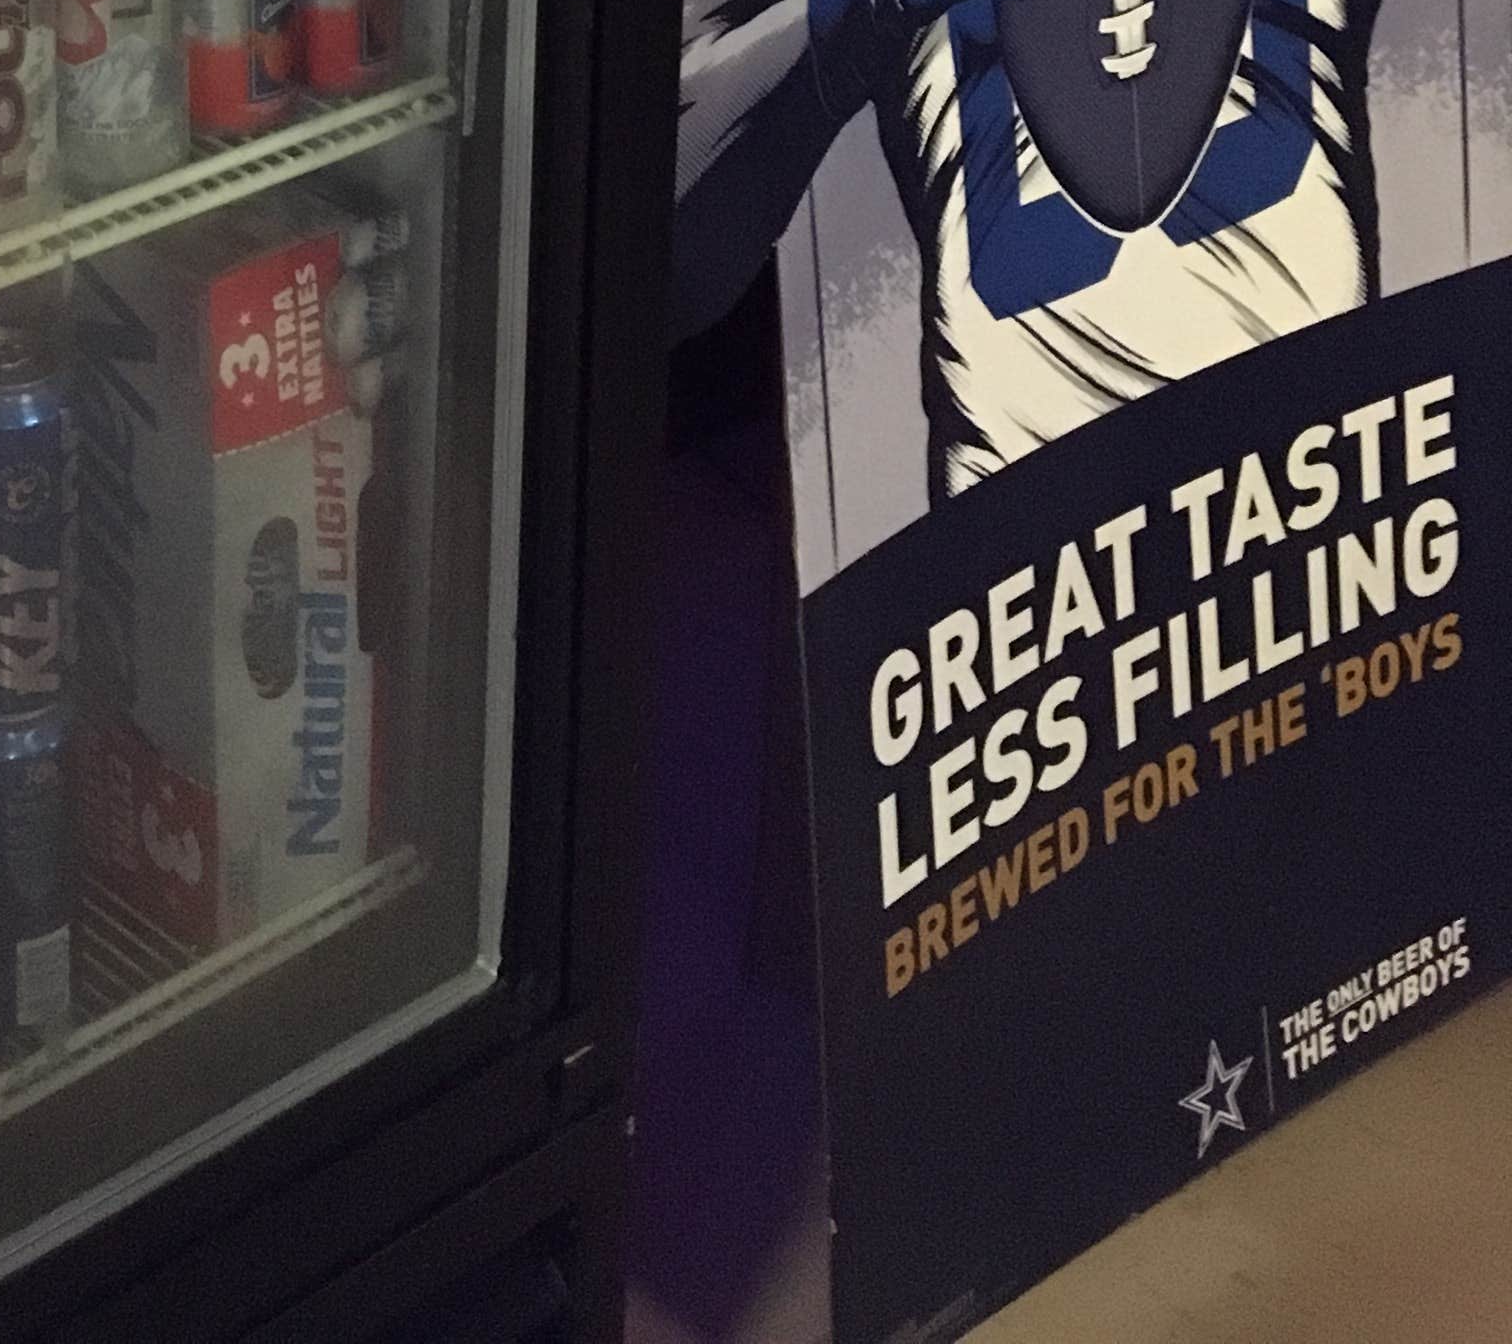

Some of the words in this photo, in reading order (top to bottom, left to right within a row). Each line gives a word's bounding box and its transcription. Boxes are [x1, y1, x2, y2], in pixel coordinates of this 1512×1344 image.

[218, 332, 272, 390] 3
[271, 286, 301, 402] EXTRA
[294, 262, 325, 407] NATTIES
[312, 422, 348, 582] LIGHT
[870, 504, 1148, 768] GREAT
[1171, 374, 1457, 582] TASTE
[285, 592, 348, 857] Natural
[878, 676, 1088, 909] LESS
[1112, 498, 1460, 751] FILLING
[884, 807, 1088, 1000] BREWED
[1102, 743, 1200, 846] FOR
[1209, 682, 1309, 780] THE
[1279, 998, 1324, 1045] THE
[1326, 969, 1374, 1015] ONLY
[1377, 936, 1434, 988] BEER
[1437, 916, 1468, 953] OF
[1281, 1023, 1337, 1080] THE
[1340, 945, 1471, 1044] COWBOYS
